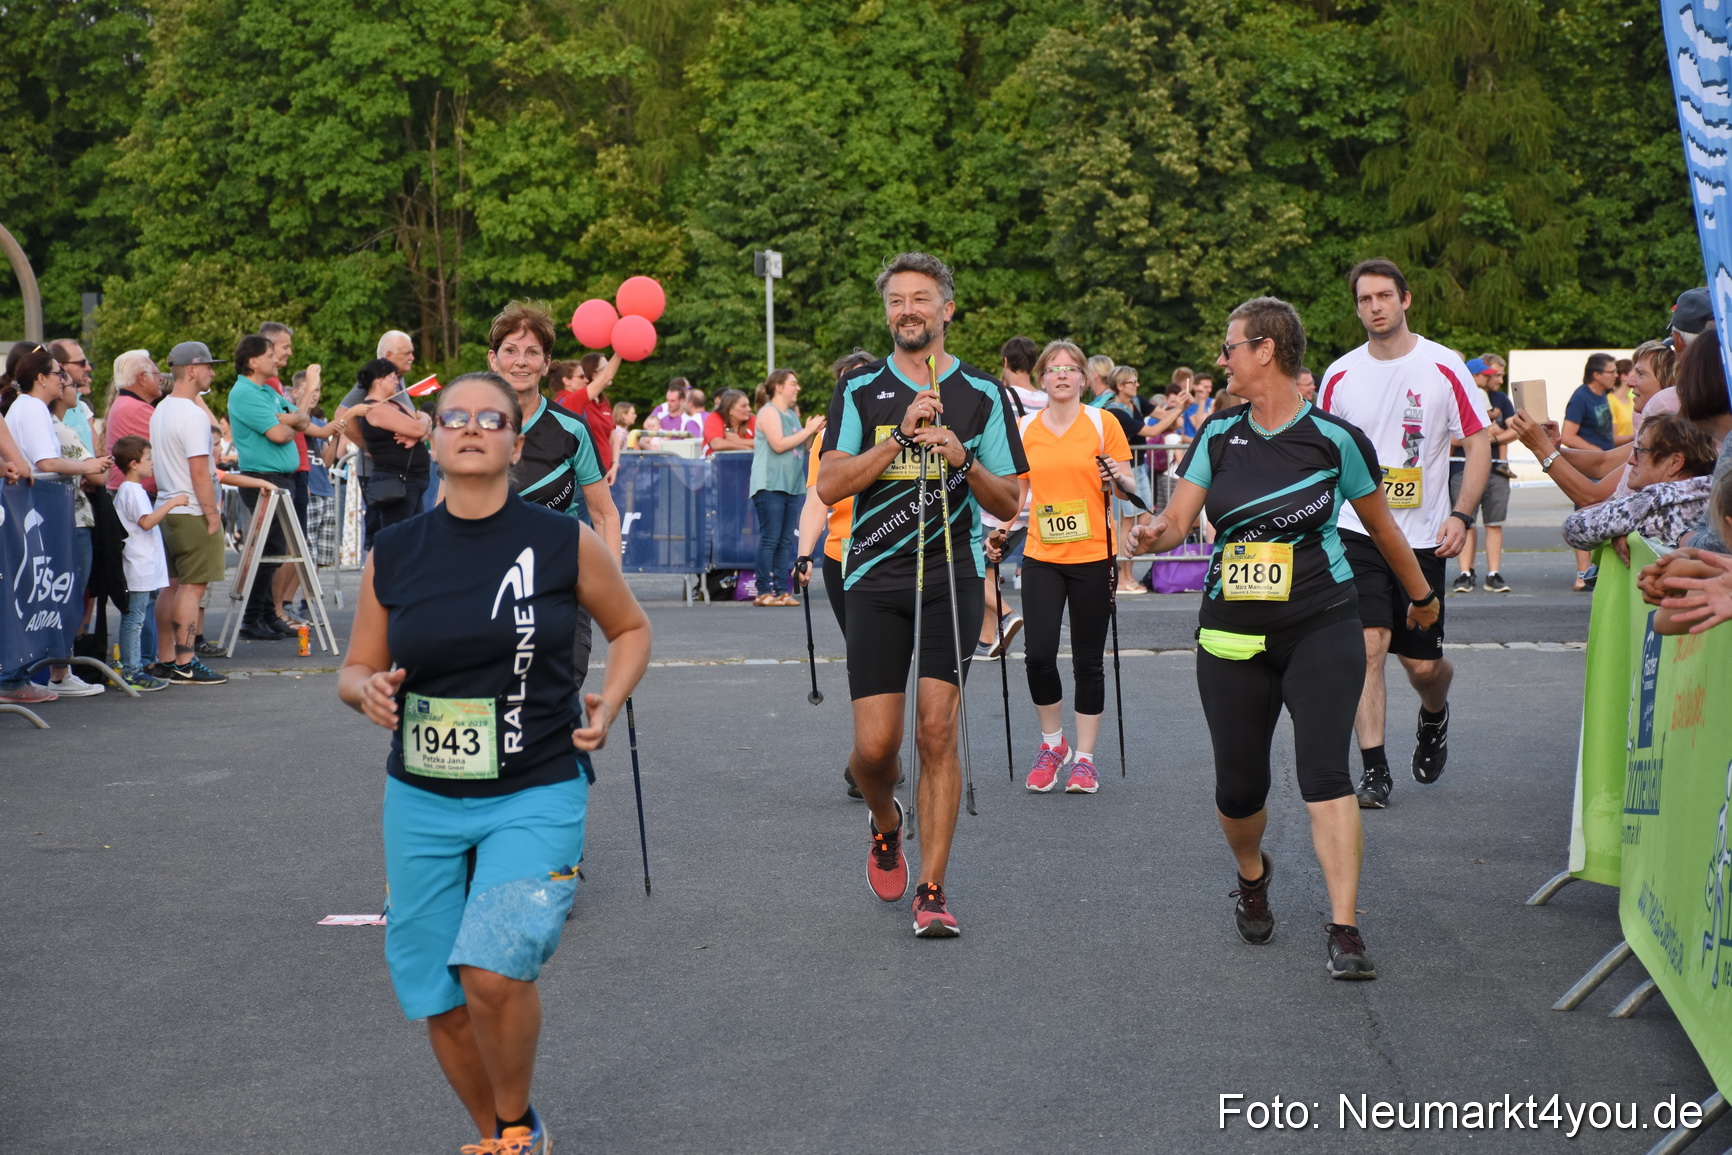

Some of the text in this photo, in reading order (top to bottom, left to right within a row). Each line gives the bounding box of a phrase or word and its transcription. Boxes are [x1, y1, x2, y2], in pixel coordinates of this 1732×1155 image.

[890, 443, 935, 465] 181
[545, 481, 573, 510] nauer
[1273, 490, 1331, 529] Donauer
[1047, 515, 1077, 532] 106
[1229, 563, 1282, 584] 2180
[503, 604, 536, 754] RAIL.ONE
[411, 723, 481, 756] 1943
[422, 754, 466, 765] Petzka Jana
